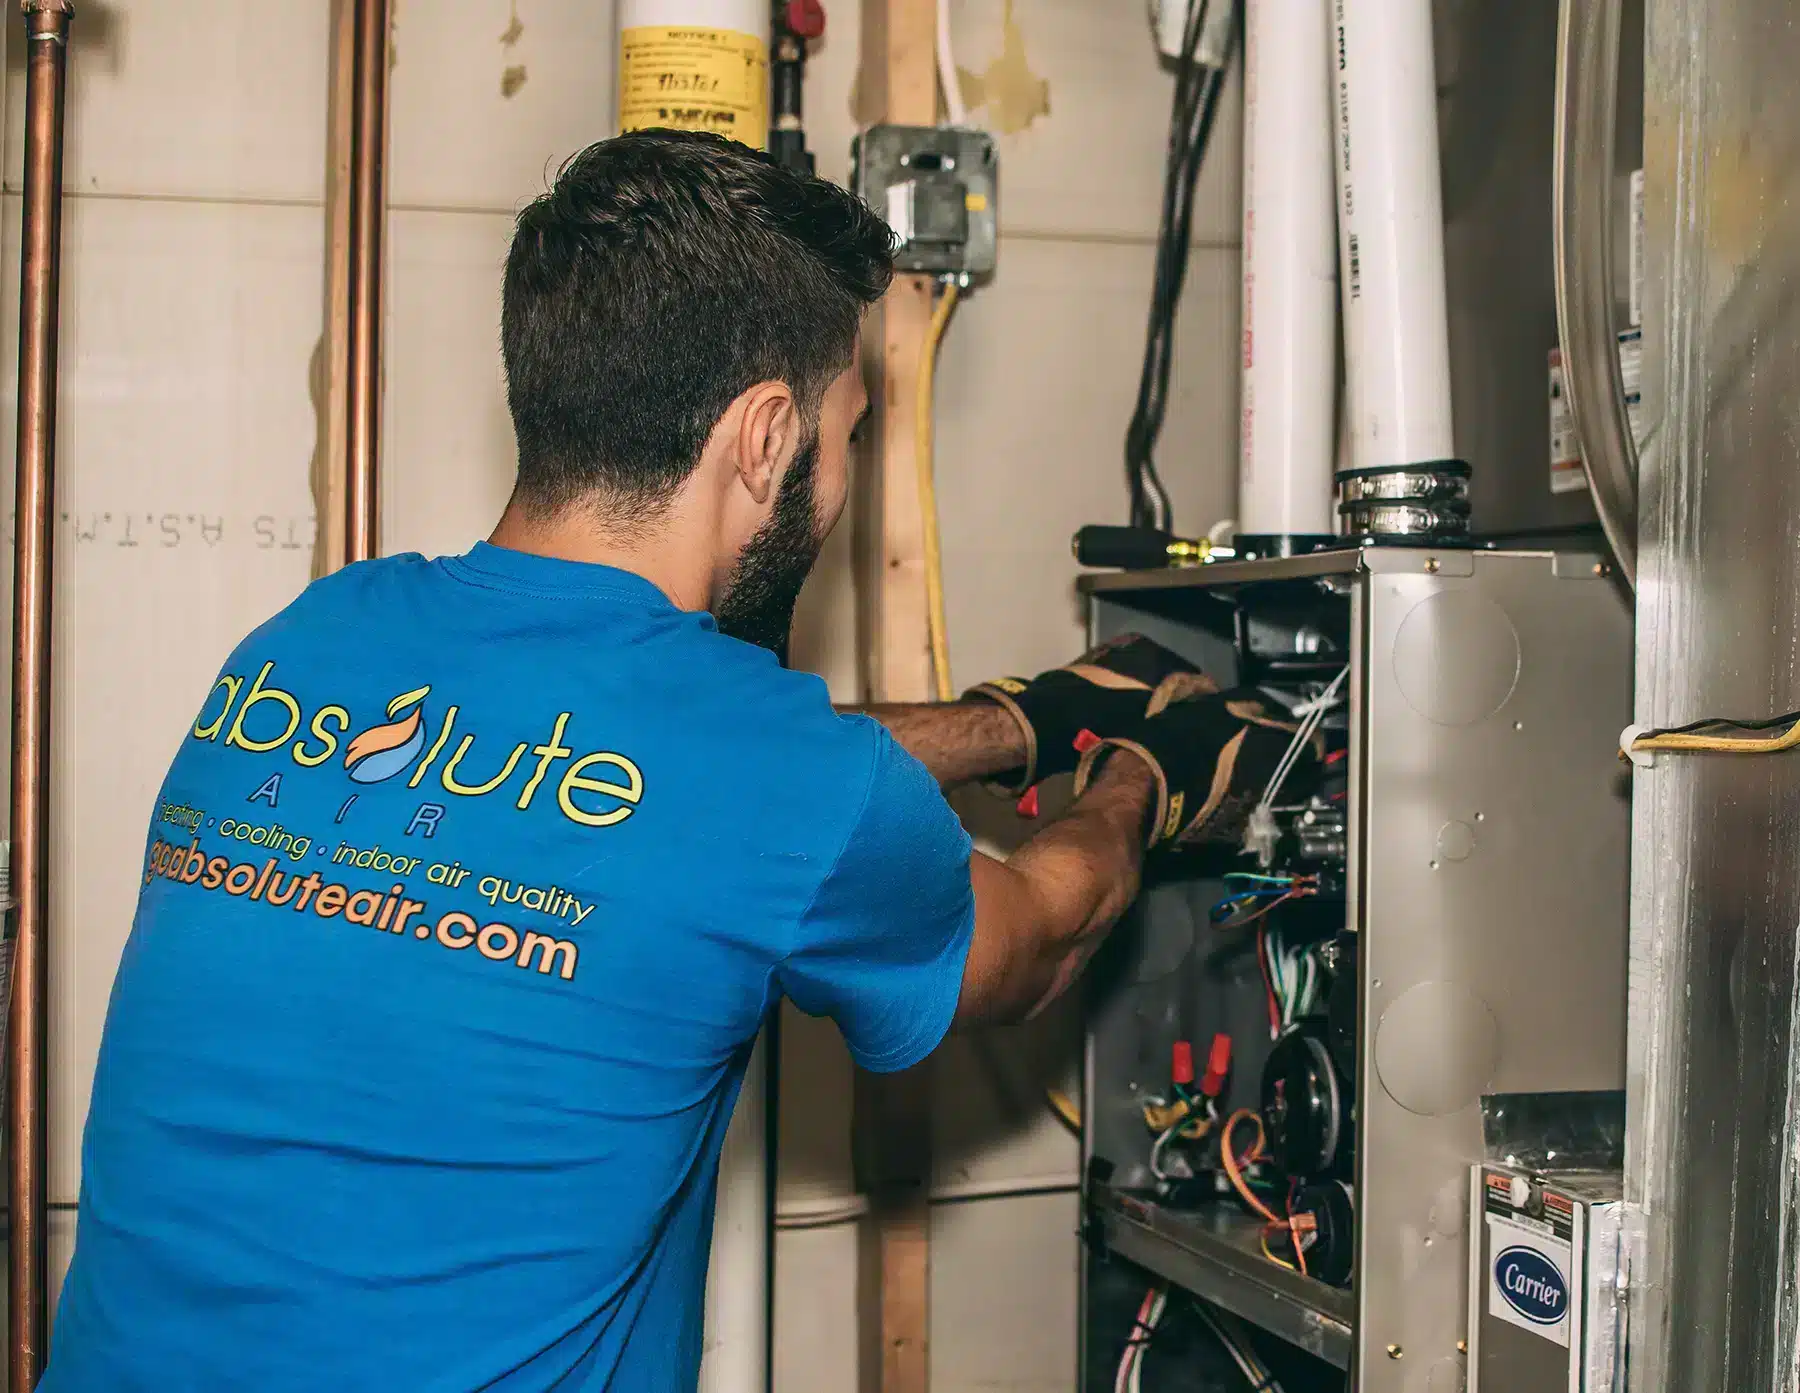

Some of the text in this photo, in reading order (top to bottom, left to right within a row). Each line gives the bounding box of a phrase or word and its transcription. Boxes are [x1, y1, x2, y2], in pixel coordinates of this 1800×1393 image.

[219, 817, 313, 861] cooling
[331, 840, 422, 877] indoor
[426, 861, 472, 889] air
[478, 874, 597, 927] quality
[1505, 1263, 1561, 1308] Carrier
